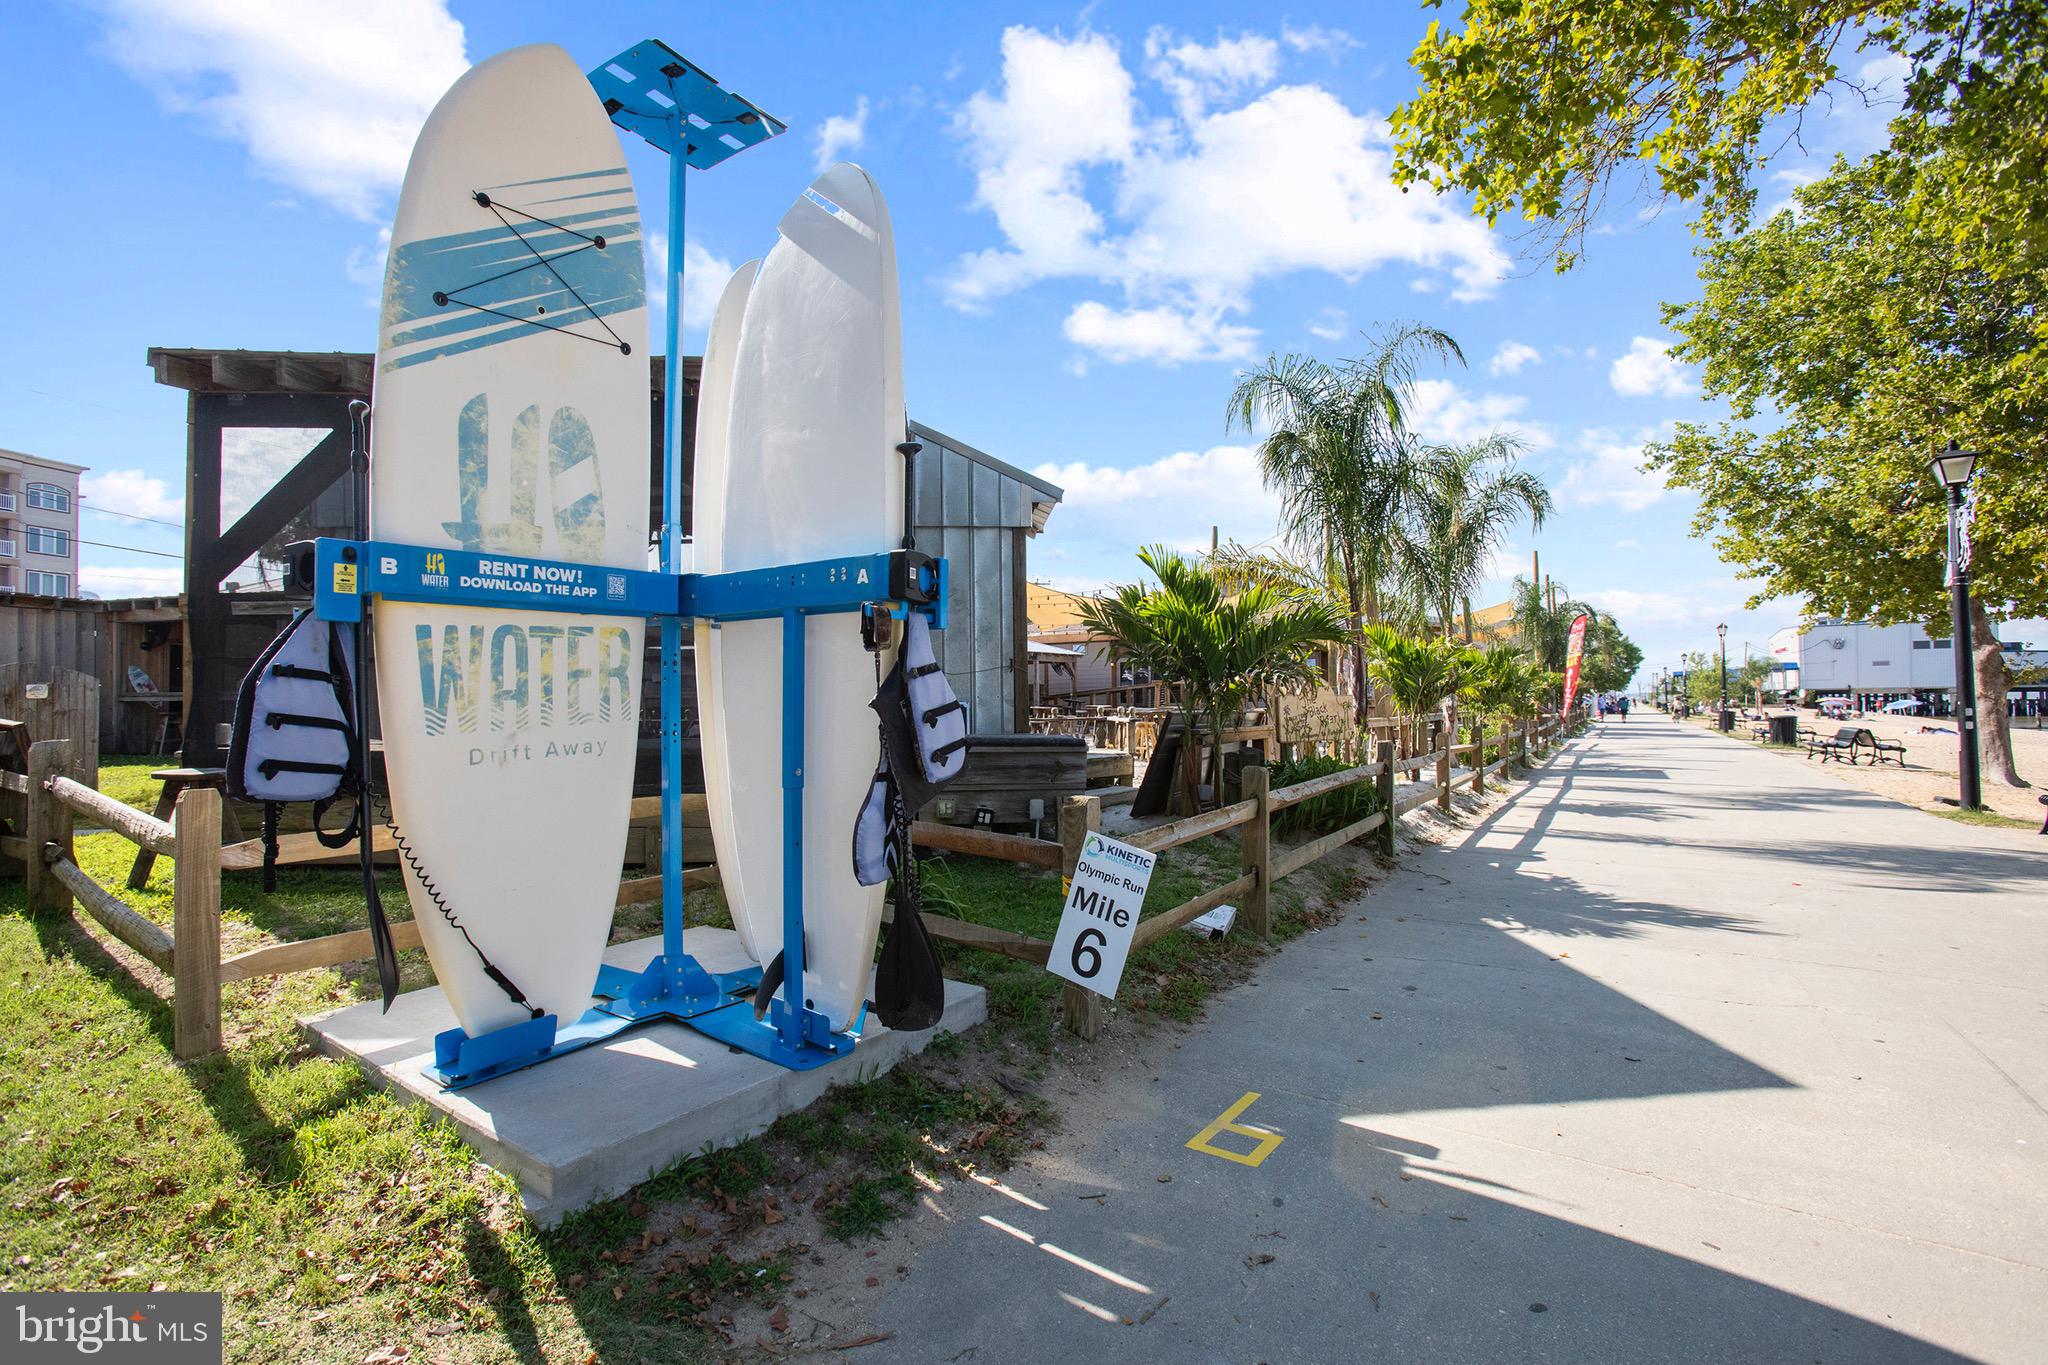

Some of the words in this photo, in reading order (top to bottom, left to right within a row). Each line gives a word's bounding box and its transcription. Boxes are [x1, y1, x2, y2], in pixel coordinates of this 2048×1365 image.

[381, 557, 398, 574] B
[479, 560, 528, 579] RENT
[534, 566, 583, 584] NOW!
[857, 568, 869, 584] A
[421, 574, 449, 588] WATER
[460, 576, 542, 593] DOWNLOAD
[545, 584, 570, 596] THE
[573, 587, 598, 598] APP
[415, 624, 631, 736] WATER
[469, 744, 531, 766] Drift
[545, 739, 607, 758] Away
[1106, 844, 1152, 869] KINETIC
[1078, 861, 1121, 886] Olympic
[1122, 878, 1144, 895] Run
[1071, 886, 1130, 928] Mile
[1071, 928, 1107, 979] 6
[1184, 1092, 1287, 1168] 6
